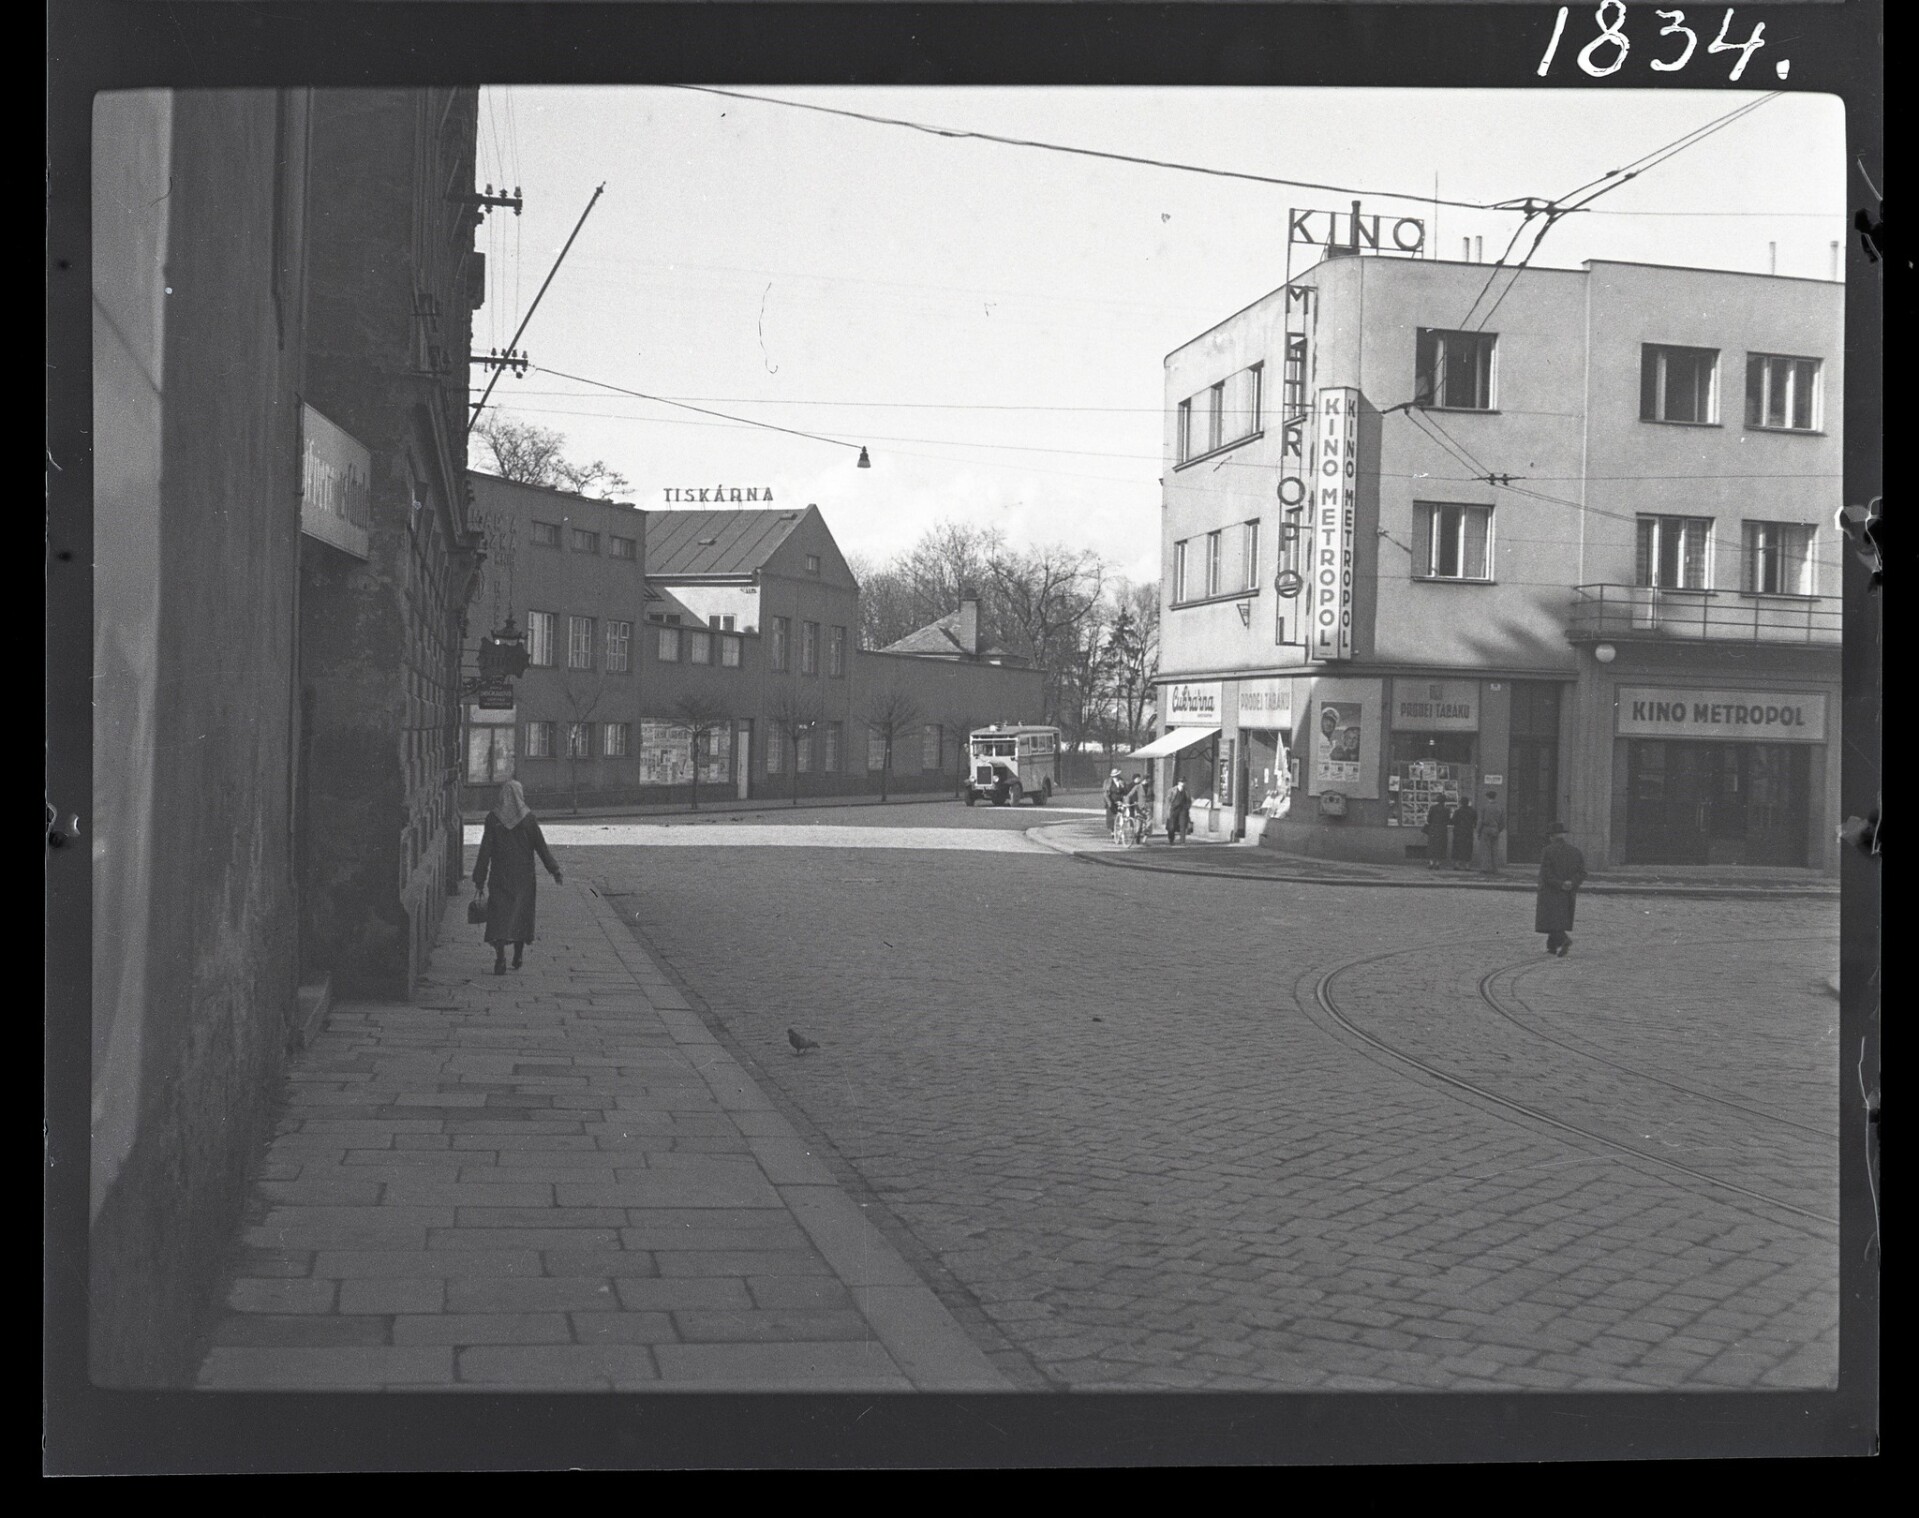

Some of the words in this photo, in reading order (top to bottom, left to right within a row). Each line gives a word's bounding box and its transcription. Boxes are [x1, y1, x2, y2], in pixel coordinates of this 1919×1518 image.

[1287, 207, 1424, 251] KINO
[1274, 285, 1308, 645] METROPOL
[1323, 397, 1340, 477] KINO
[1345, 398, 1356, 478] KINO
[662, 483, 774, 502] TISKÁRNA
[1318, 488, 1338, 647] METROPOL
[1342, 489, 1354, 648] METROPOL
[1400, 702, 1432, 718] PRODEJ
[1632, 701, 1687, 723] KINO
[1693, 703, 1806, 726] METROPOL
